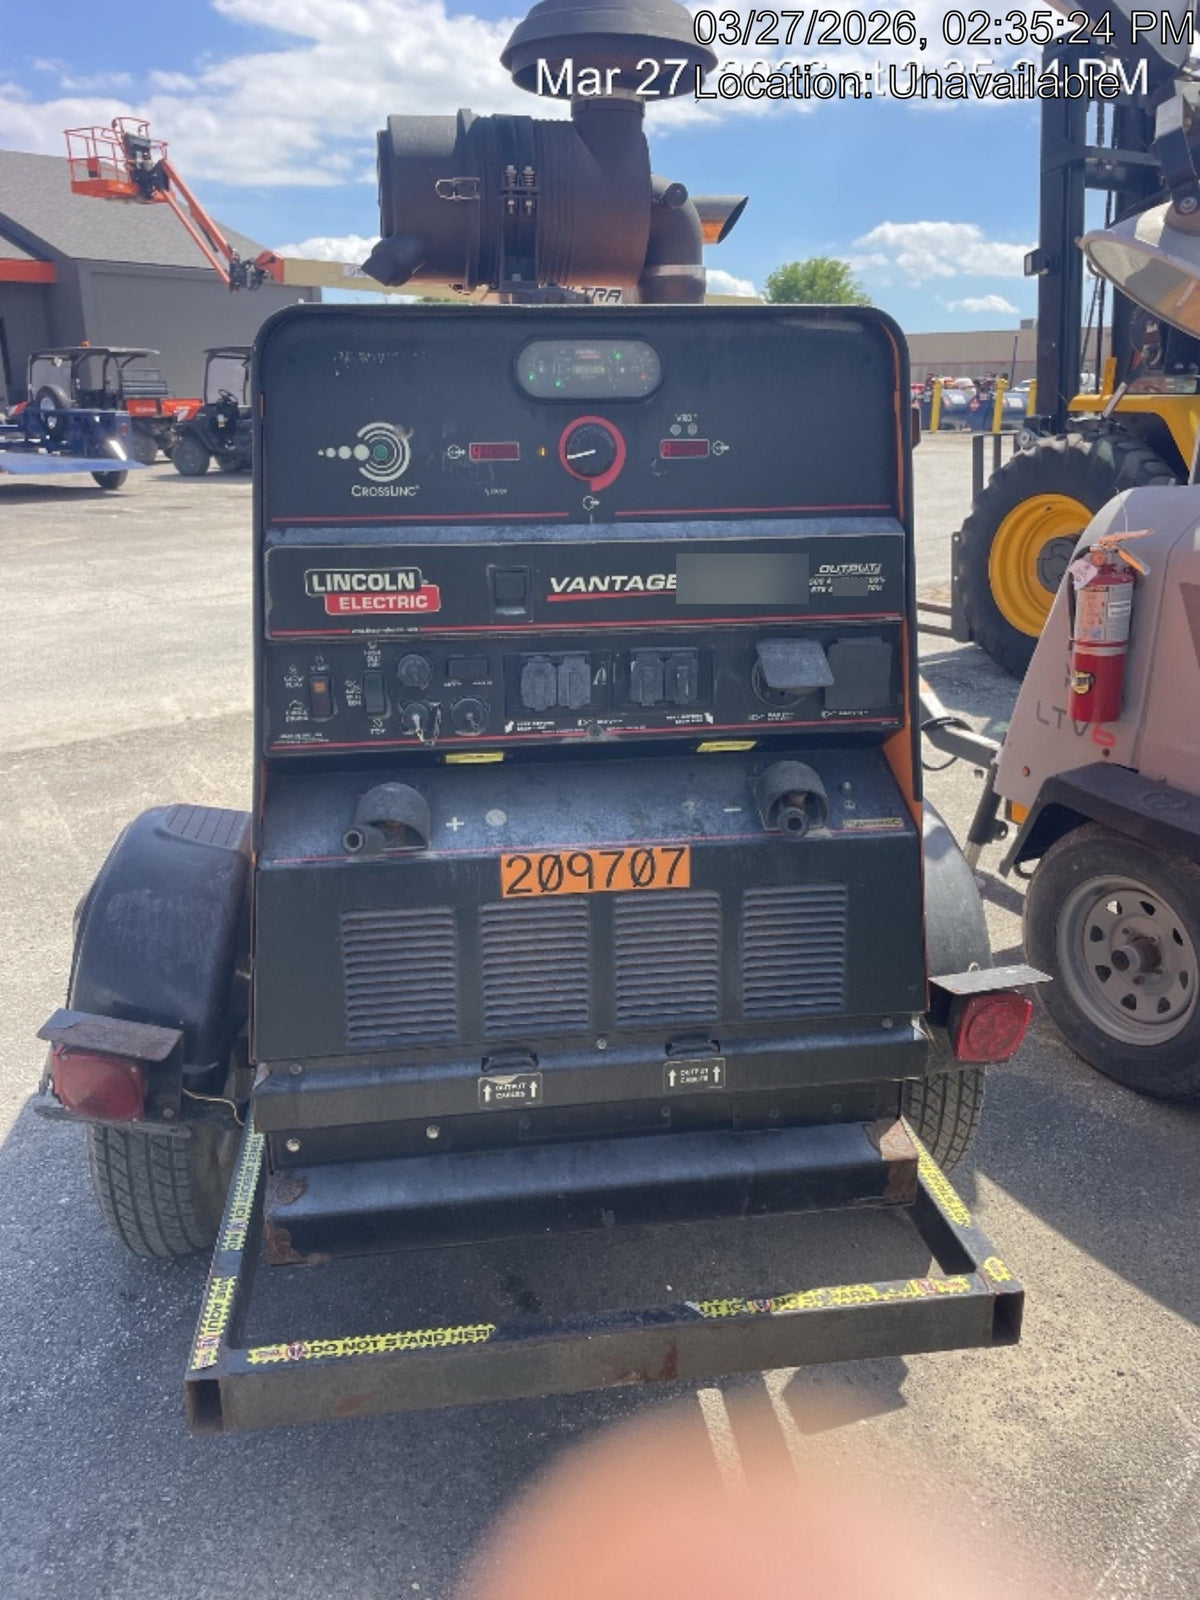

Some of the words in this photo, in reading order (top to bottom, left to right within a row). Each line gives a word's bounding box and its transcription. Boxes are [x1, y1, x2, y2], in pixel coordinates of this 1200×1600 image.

[819, 563, 880, 574] OUTPUT
[312, 572, 415, 592] LINCOLN
[550, 573, 677, 593] VANTAGE
[339, 595, 428, 610] ELECTRIC
[505, 847, 686, 895] 209707
[311, 1343, 338, 1354] DO
[343, 1340, 379, 1351] NOT
[385, 1332, 446, 1347] STAND
[451, 1328, 492, 1340] HER
